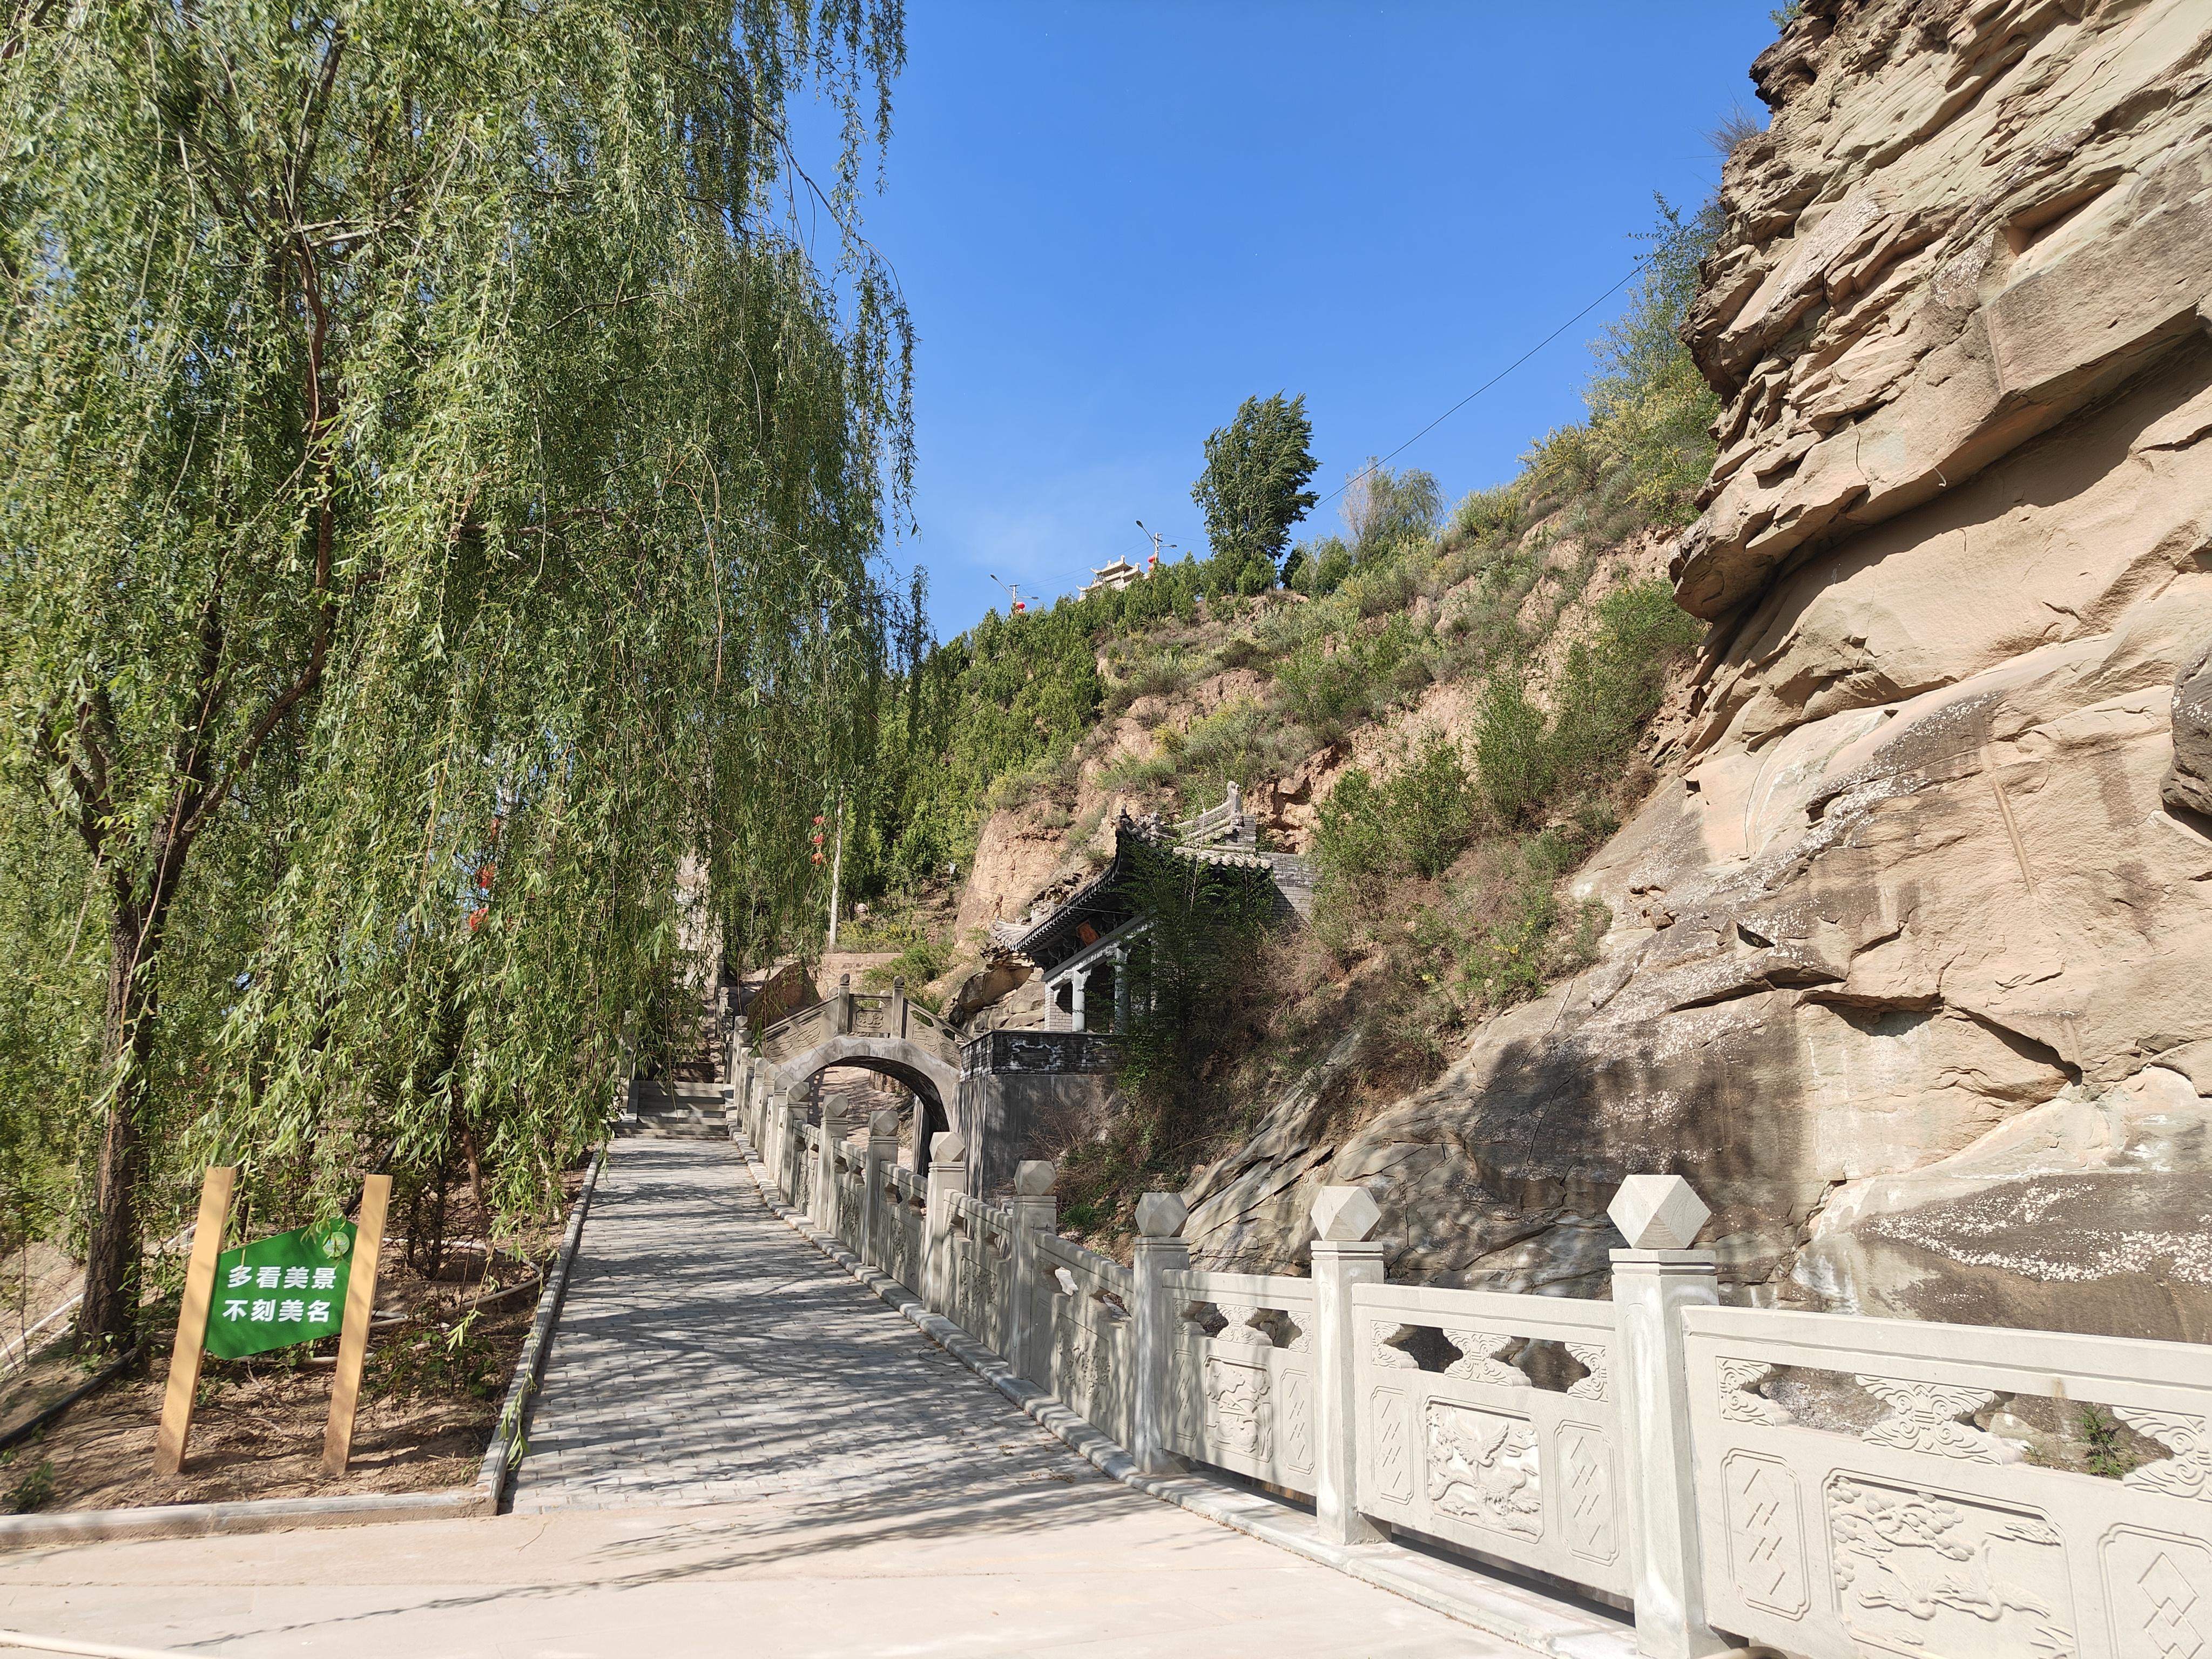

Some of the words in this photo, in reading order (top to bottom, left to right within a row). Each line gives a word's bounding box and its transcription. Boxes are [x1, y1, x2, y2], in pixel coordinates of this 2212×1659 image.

[227, 1265, 337, 1290] 多看美景
[222, 1299, 331, 1323] 不刻美名
